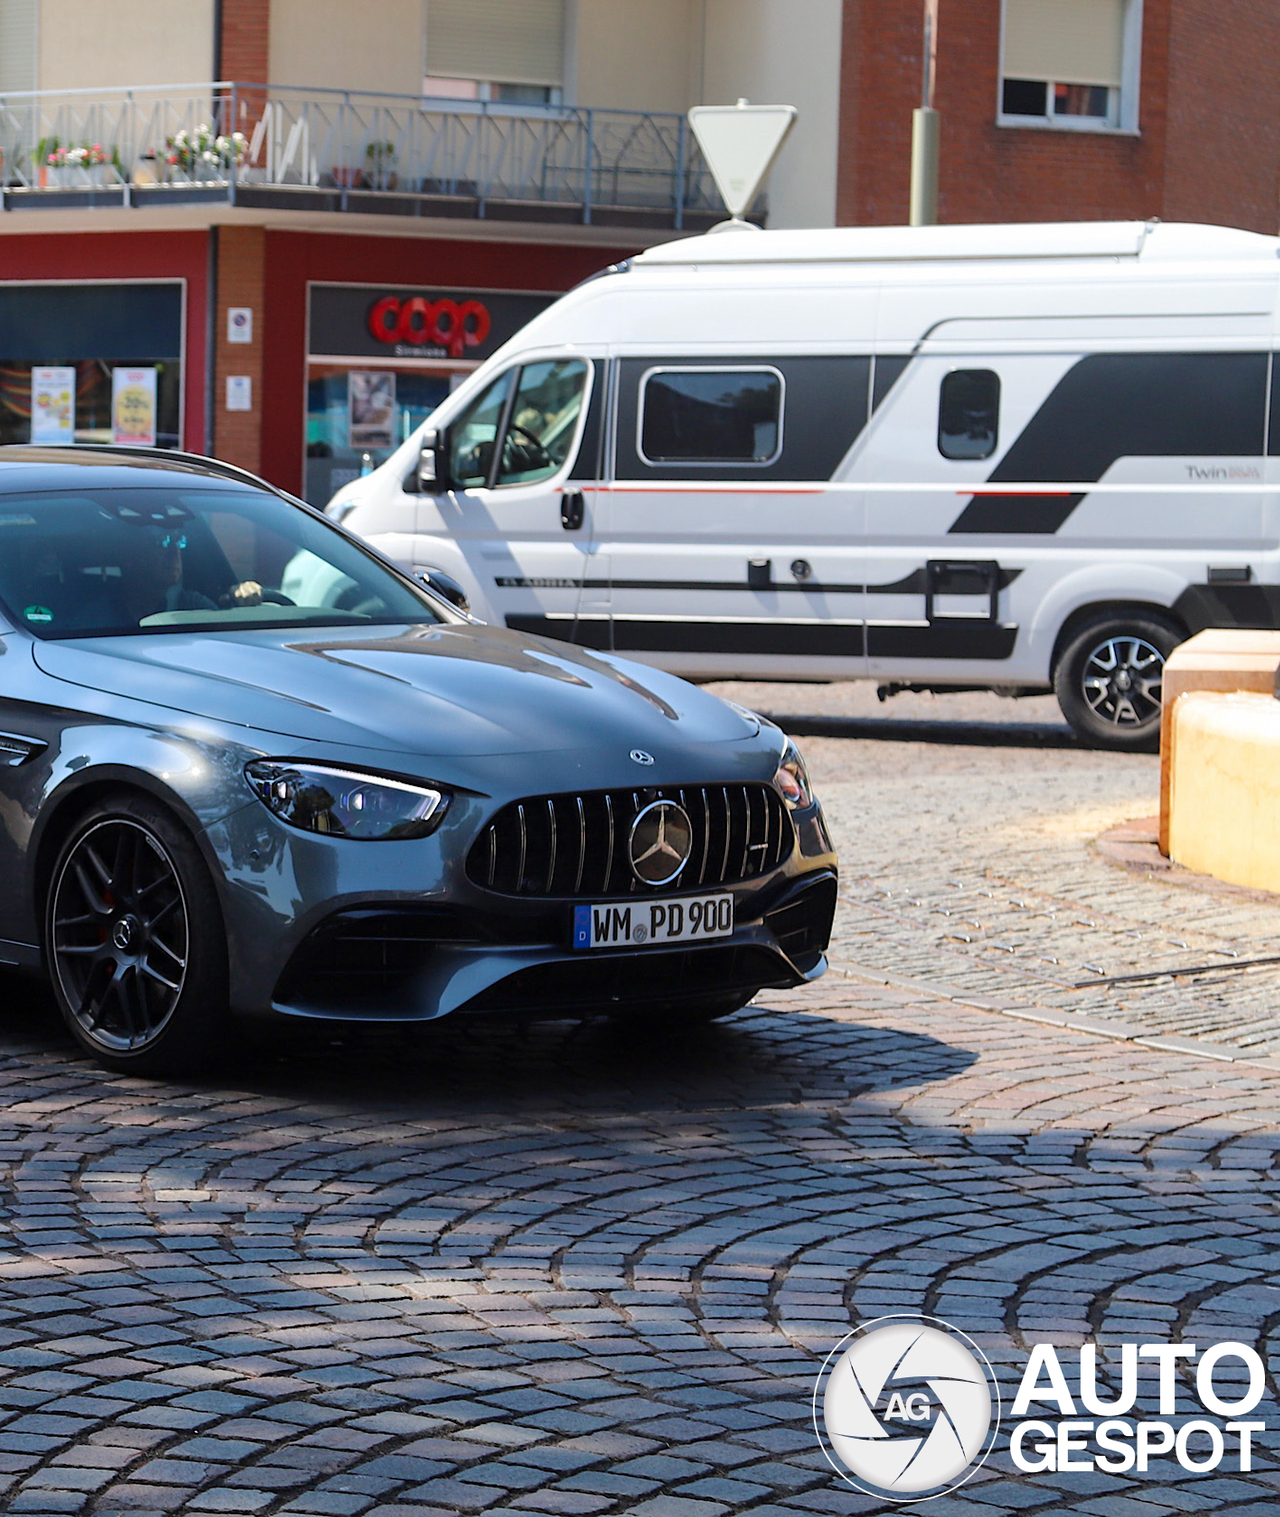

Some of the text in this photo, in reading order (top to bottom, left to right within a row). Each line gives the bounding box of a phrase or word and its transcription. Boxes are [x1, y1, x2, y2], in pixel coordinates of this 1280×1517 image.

[368, 296, 491, 356] coop
[1184, 465, 1227, 478] Twin
[522, 578, 577, 588] ADRIA
[594, 899, 731, 942] WM PD 900
[579, 931, 587, 941] D
